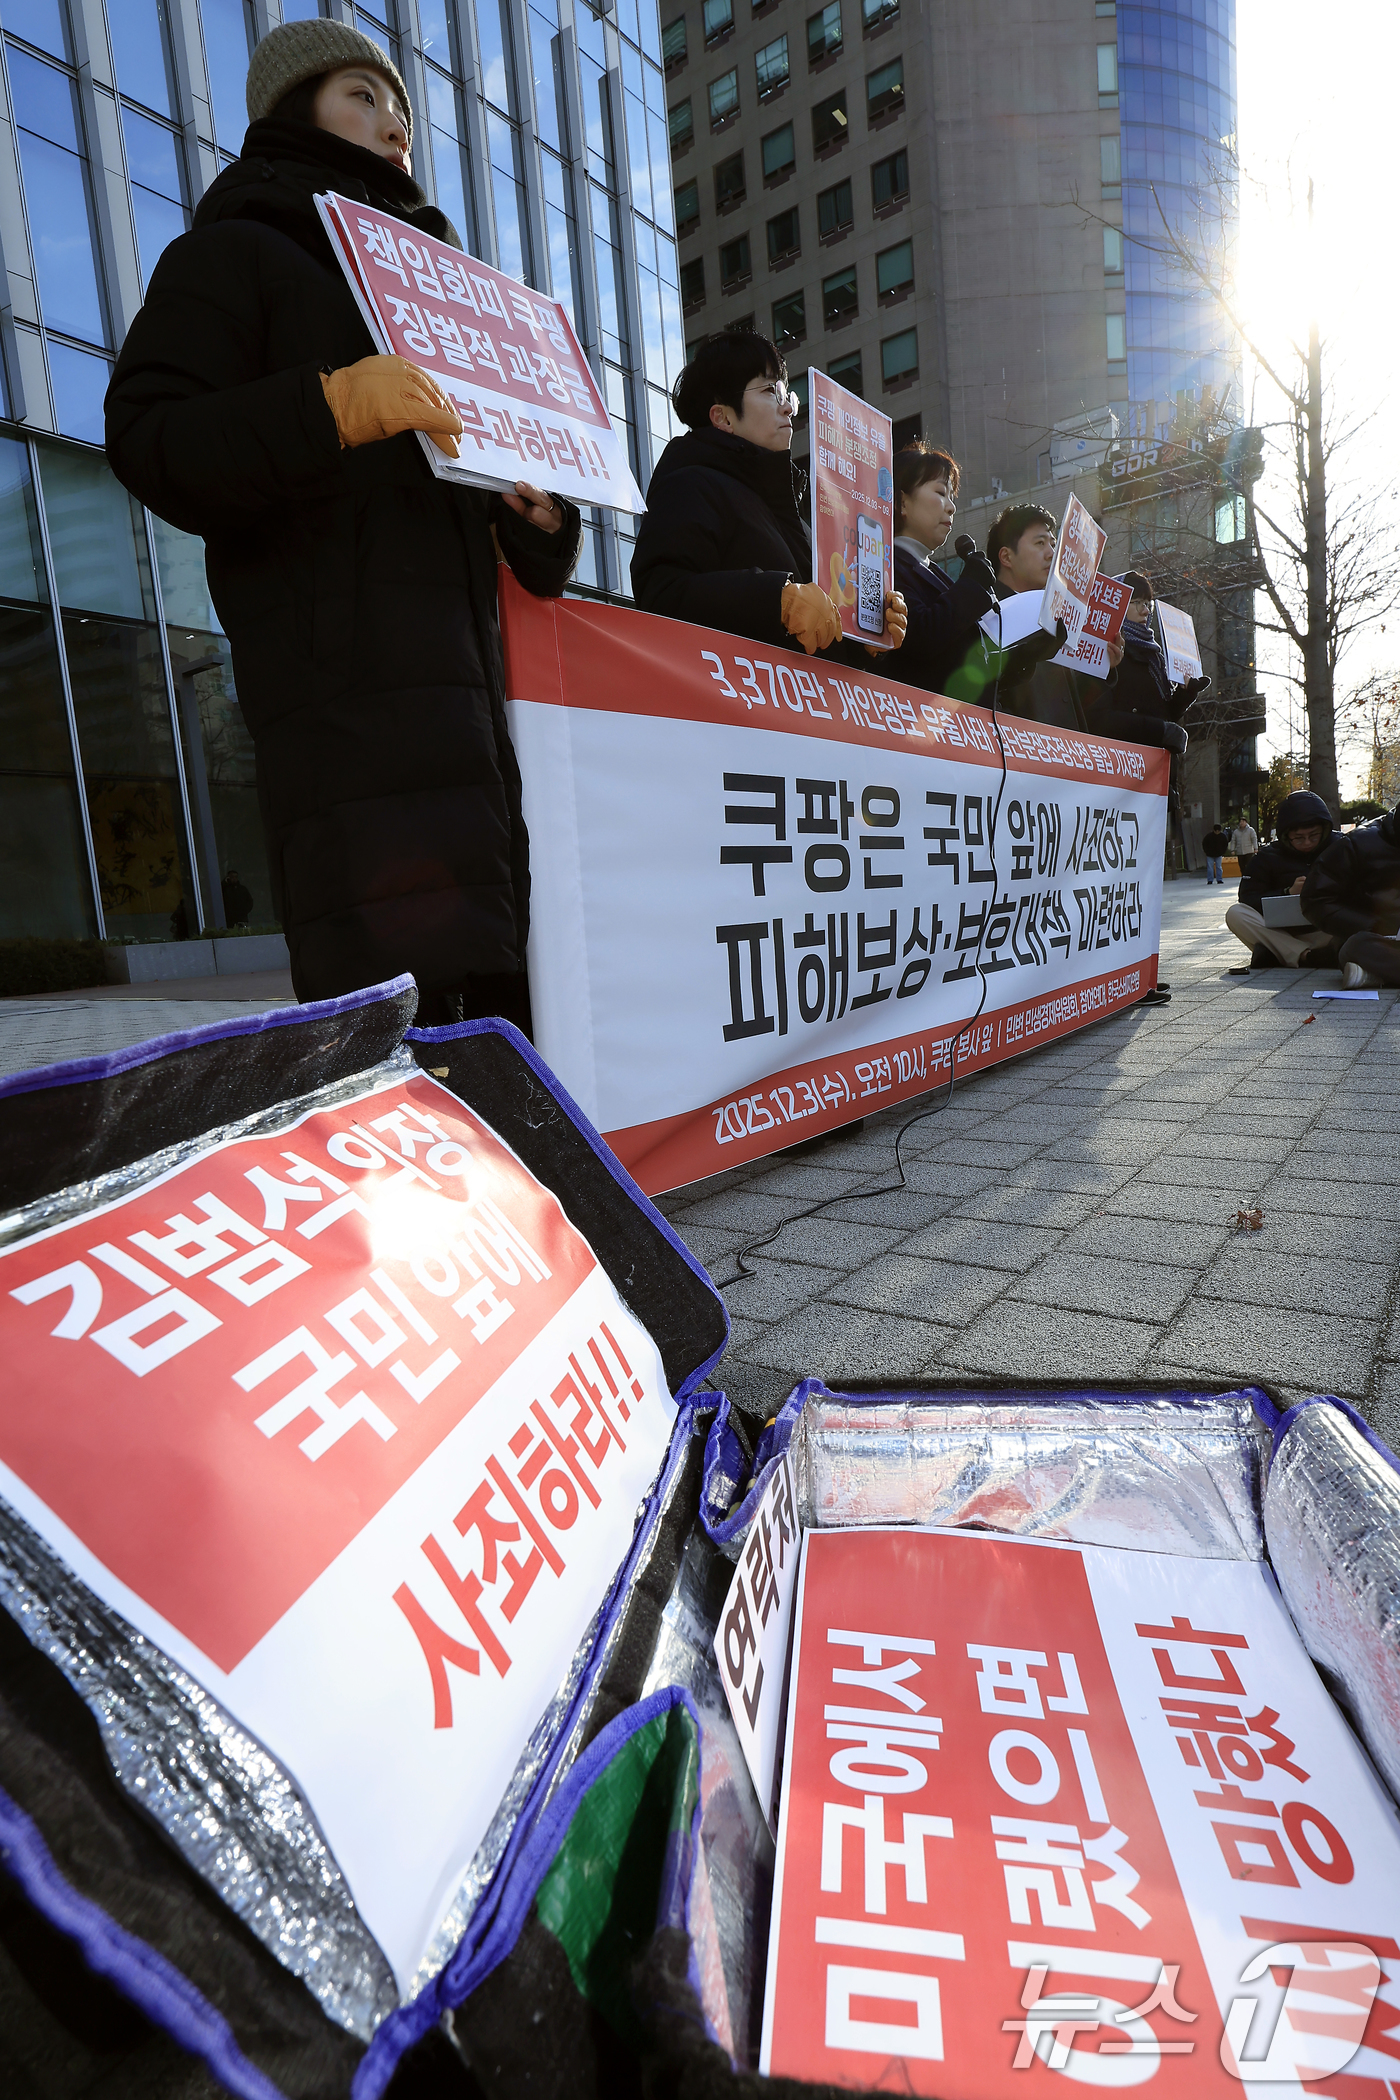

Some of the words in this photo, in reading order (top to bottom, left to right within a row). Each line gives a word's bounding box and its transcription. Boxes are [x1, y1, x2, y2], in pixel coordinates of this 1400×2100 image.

[357, 216, 513, 330] 책임회피
[506, 288, 572, 354] 쿠팡
[384, 292, 508, 384] 징벌적
[500, 340, 597, 416] 과징금
[448, 392, 610, 481] 부과하라!!
[818, 394, 835, 421] 쿠팡
[838, 406, 869, 442] 개인정보
[870, 427, 886, 452] 유출
[818, 420, 843, 451] 피해자
[845, 436, 877, 470] 분쟁조정
[819, 445, 836, 472] 함께
[838, 455, 857, 483] 해요!
[1112, 450, 1158, 478] GDR
[844, 525, 891, 568] coupang
[851, 489, 878, 510] 2025.12.03
[1060, 544, 1092, 596] 집단소송법
[1090, 609, 1112, 635] 대책
[1100, 582, 1122, 610] 보호
[700, 650, 833, 720] 3,370만
[828, 678, 926, 738] 개인정보
[920, 703, 996, 754] 유출사태
[987, 721, 1094, 771] 집단분쟁조정신청
[1087, 743, 1114, 775] 돌입
[1110, 748, 1146, 781] 기자회견
[720, 772, 905, 897] 쿠팡은
[923, 791, 997, 885] 국민
[1007, 800, 1062, 881] 앞에
[1064, 806, 1139, 875] 사죄하고
[716, 889, 1071, 1042] 피해보상·보호대책
[1072, 881, 1143, 952] 마련하라
[711, 1071, 856, 1145] 2025.12.3(수).
[854, 1056, 892, 1098] 오전
[893, 1045, 928, 1084] 10시,
[930, 1037, 956, 1072] 쿠팡
[956, 1026, 981, 1064] 본사
[981, 1022, 994, 1054] 앞
[1006, 1012, 1024, 1044] 민변
[7, 1151, 384, 1378] 김범석
[326, 1102, 474, 1192] 의장
[231, 1267, 462, 1463] 국민
[409, 1196, 553, 1345] 앞에
[391, 1321, 644, 1729] 사죄하라!!
[1133, 1615, 1355, 1889] 망했다
[814, 1628, 967, 2062] 미국에서
[966, 1642, 1169, 2087] 이랬으면
